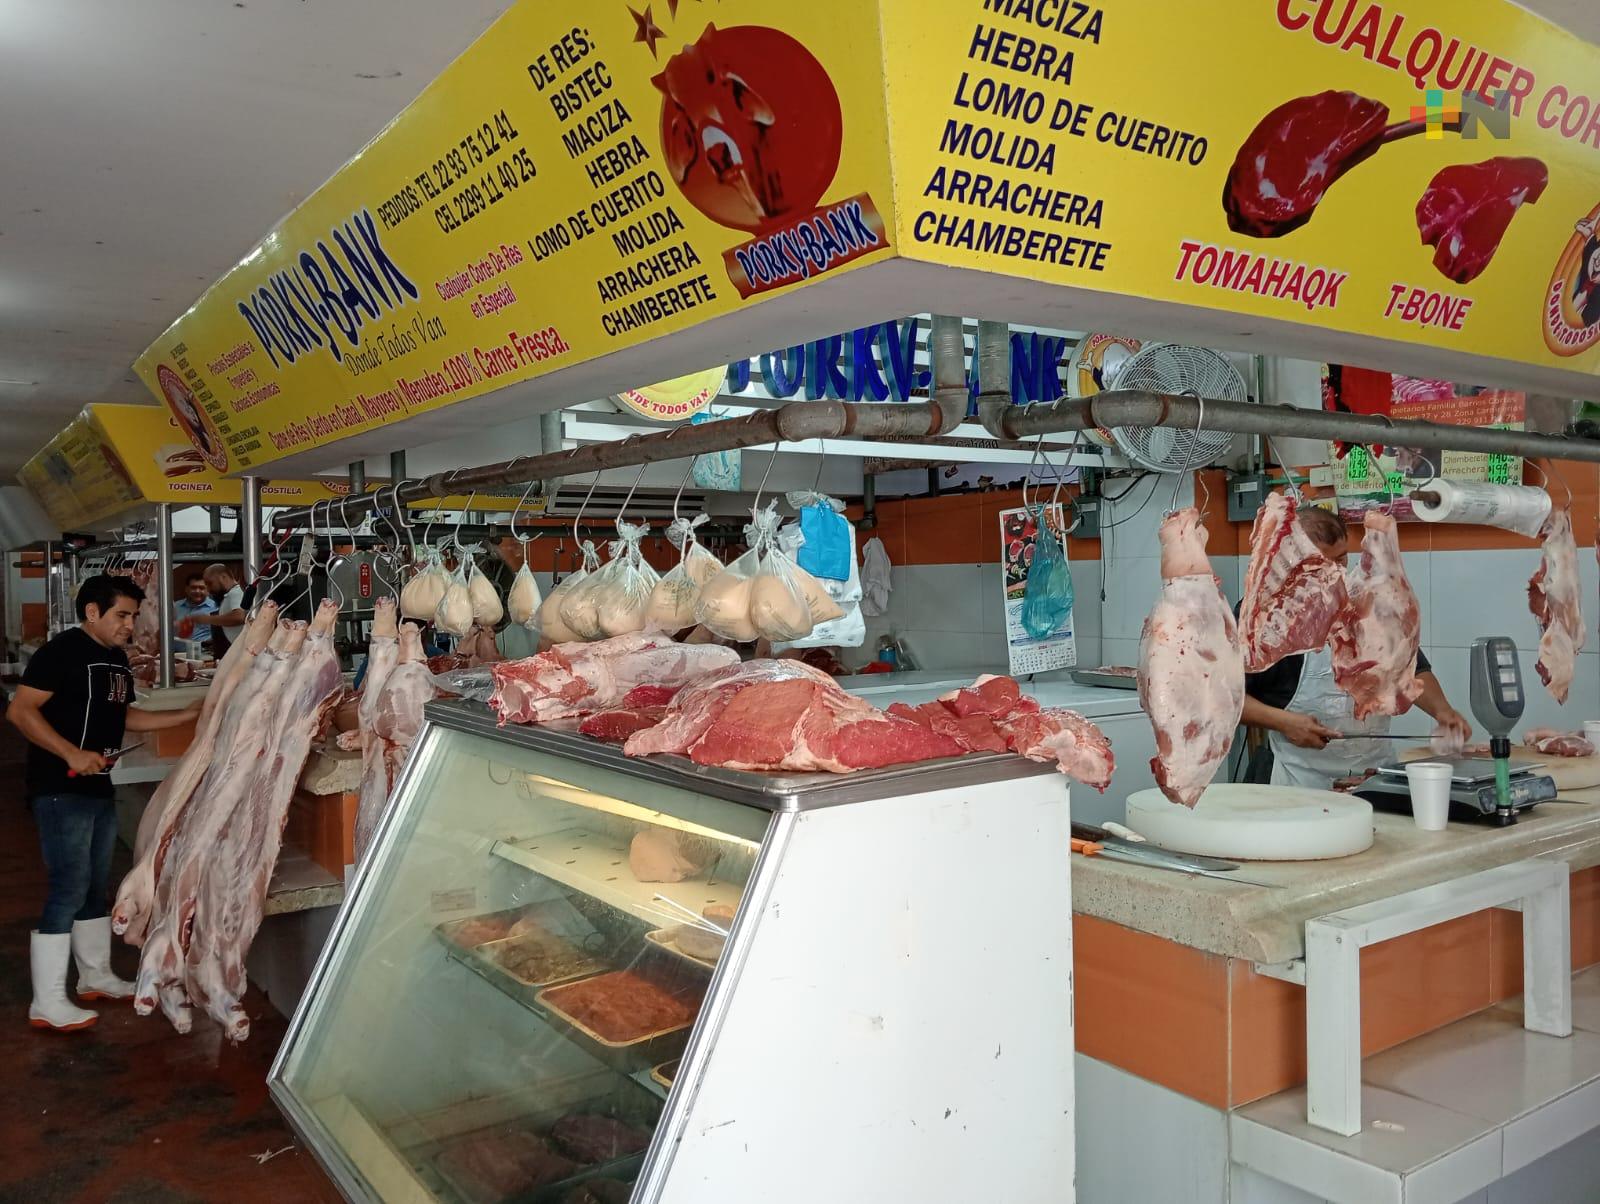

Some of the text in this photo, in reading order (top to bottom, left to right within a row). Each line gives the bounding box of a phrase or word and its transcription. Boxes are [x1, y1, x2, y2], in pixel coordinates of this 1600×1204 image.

[527, 27, 595, 91] DE RES:
[967, 24, 1075, 86] HEBRA
[1276, 0, 1535, 118] CUALQUIER
[550, 61, 613, 122] BISTEC
[953, 72, 1208, 166] LOMO DE CUERITO
[561, 98, 632, 160] MACIZA
[938, 118, 1056, 175] MOLIDA
[377, 109, 519, 231] PEDIDOS: TEL 22 93 75 12 41
[434, 147, 537, 234] CEL 2299 11 40 25
[585, 134, 650, 190] HEBRA
[527, 170, 665, 263] LOMO DE CUERITO
[923, 166, 1104, 229] ARRACHERA
[612, 205, 684, 259] MOLIDA
[913, 210, 1112, 272] CHAMBERETE
[435, 245, 523, 301] Cualquier Corte De Res
[470, 281, 517, 318] en Especial
[596, 240, 701, 304] ARRACHERA
[1174, 241, 1346, 311] TOMAHAQK
[600, 274, 716, 338] CHAMBERETE
[1384, 284, 1472, 330] T-BONE
[344, 311, 447, 377] Donde Todos Van
[357, 389, 401, 422] Mayoreo
[474, 344, 518, 378] Carne
[509, 326, 570, 366] Fresca.
[652, 402, 688, 415] TODOS
[689, 388, 710, 408] VAN
[168, 483, 212, 492] TOCINETA
[261, 486, 302, 495] COSTILLA
[1442, 466, 1485, 475] Arrachera
